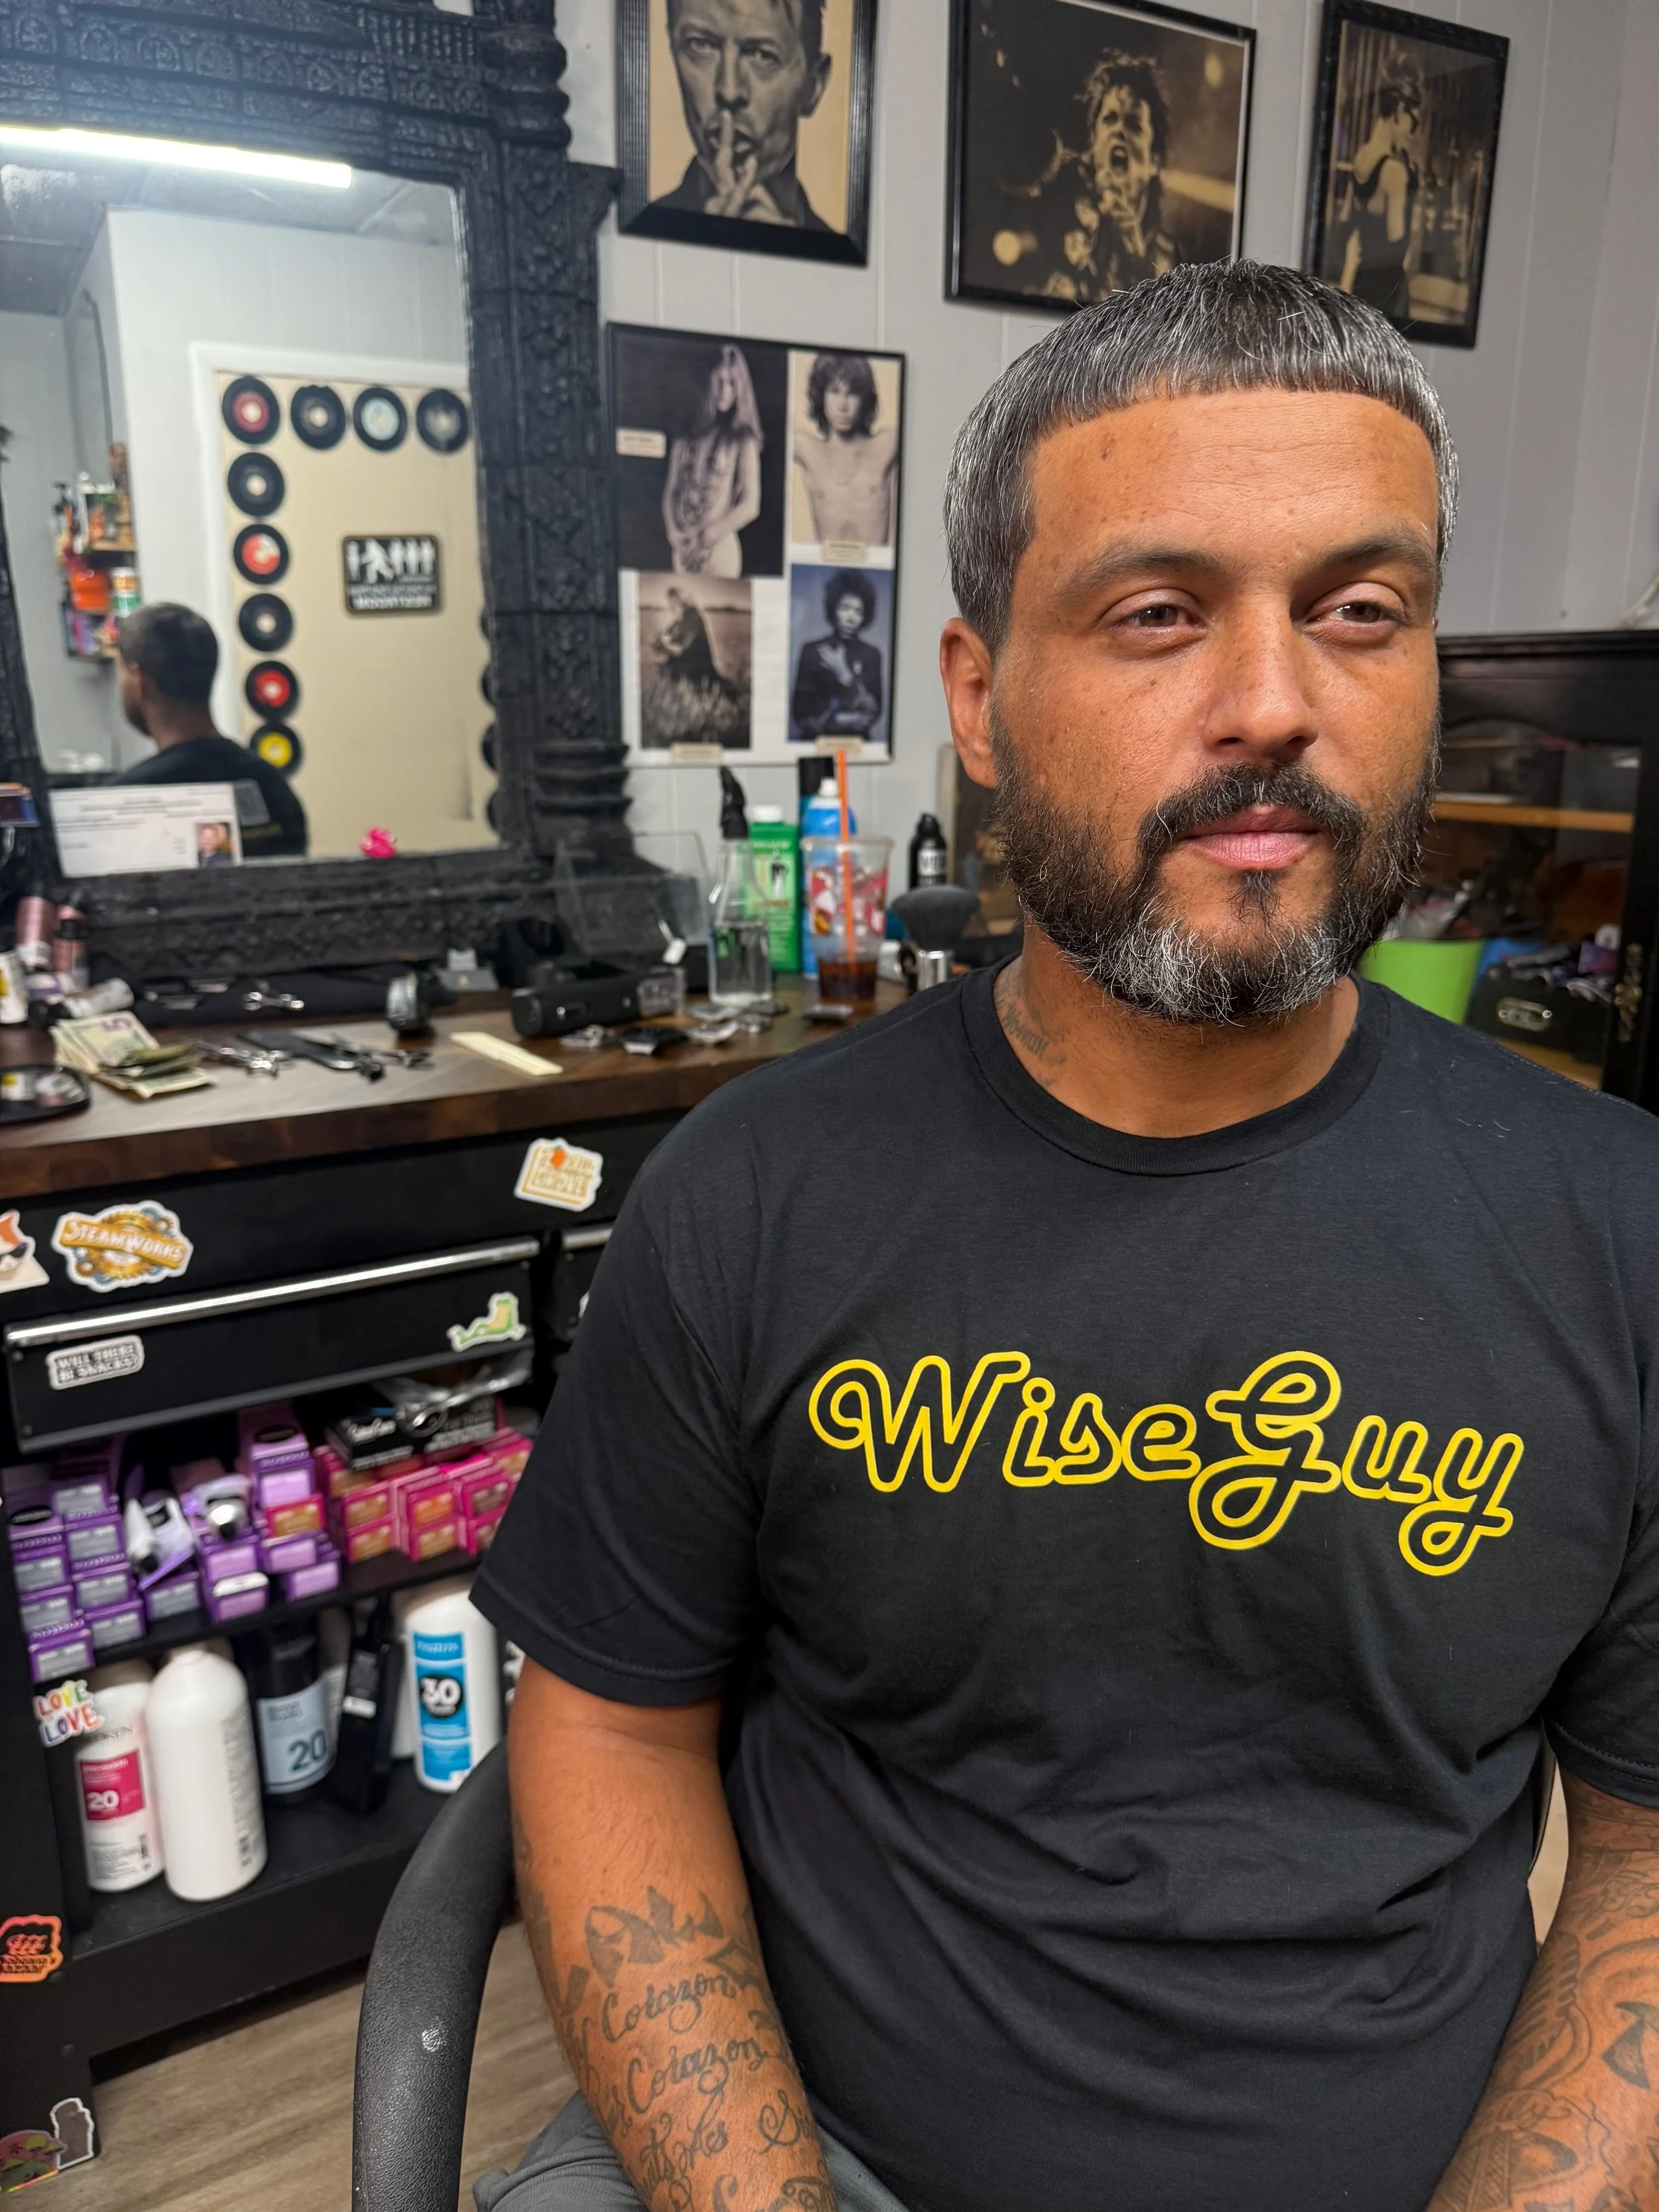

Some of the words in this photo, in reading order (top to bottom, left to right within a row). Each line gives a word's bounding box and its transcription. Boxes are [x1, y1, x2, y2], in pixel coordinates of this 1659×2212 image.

[37, 1682, 92, 1717] LOVE
[420, 1676, 462, 1707] 30
[44, 1703, 102, 1743] LOVE
[288, 1727, 327, 1771] 20
[86, 1790, 120, 1812] 20
